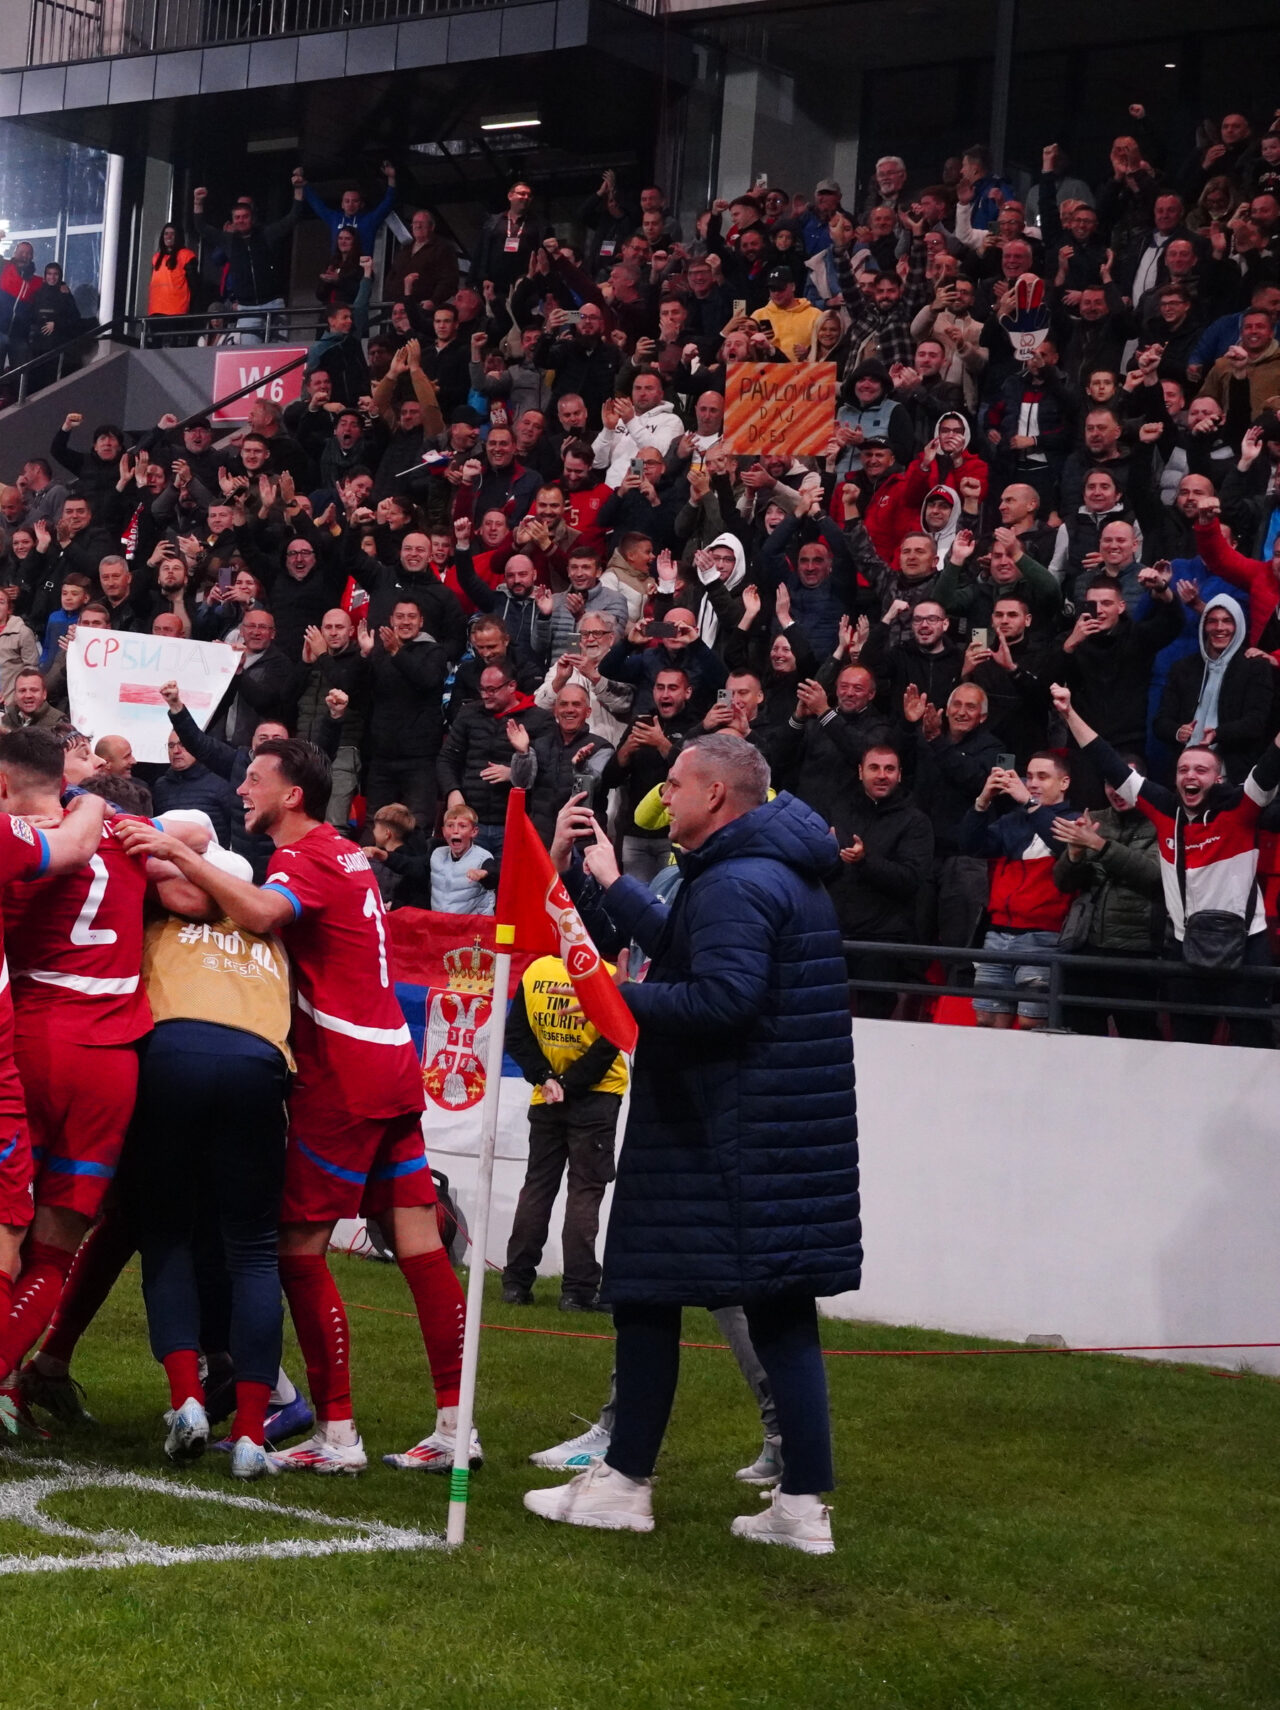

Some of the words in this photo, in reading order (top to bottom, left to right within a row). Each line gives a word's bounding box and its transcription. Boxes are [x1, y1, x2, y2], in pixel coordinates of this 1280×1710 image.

[239, 366, 284, 403] W6
[748, 424, 787, 443] DRES
[70, 852, 118, 946] 2
[546, 996, 570, 1010] TIM
